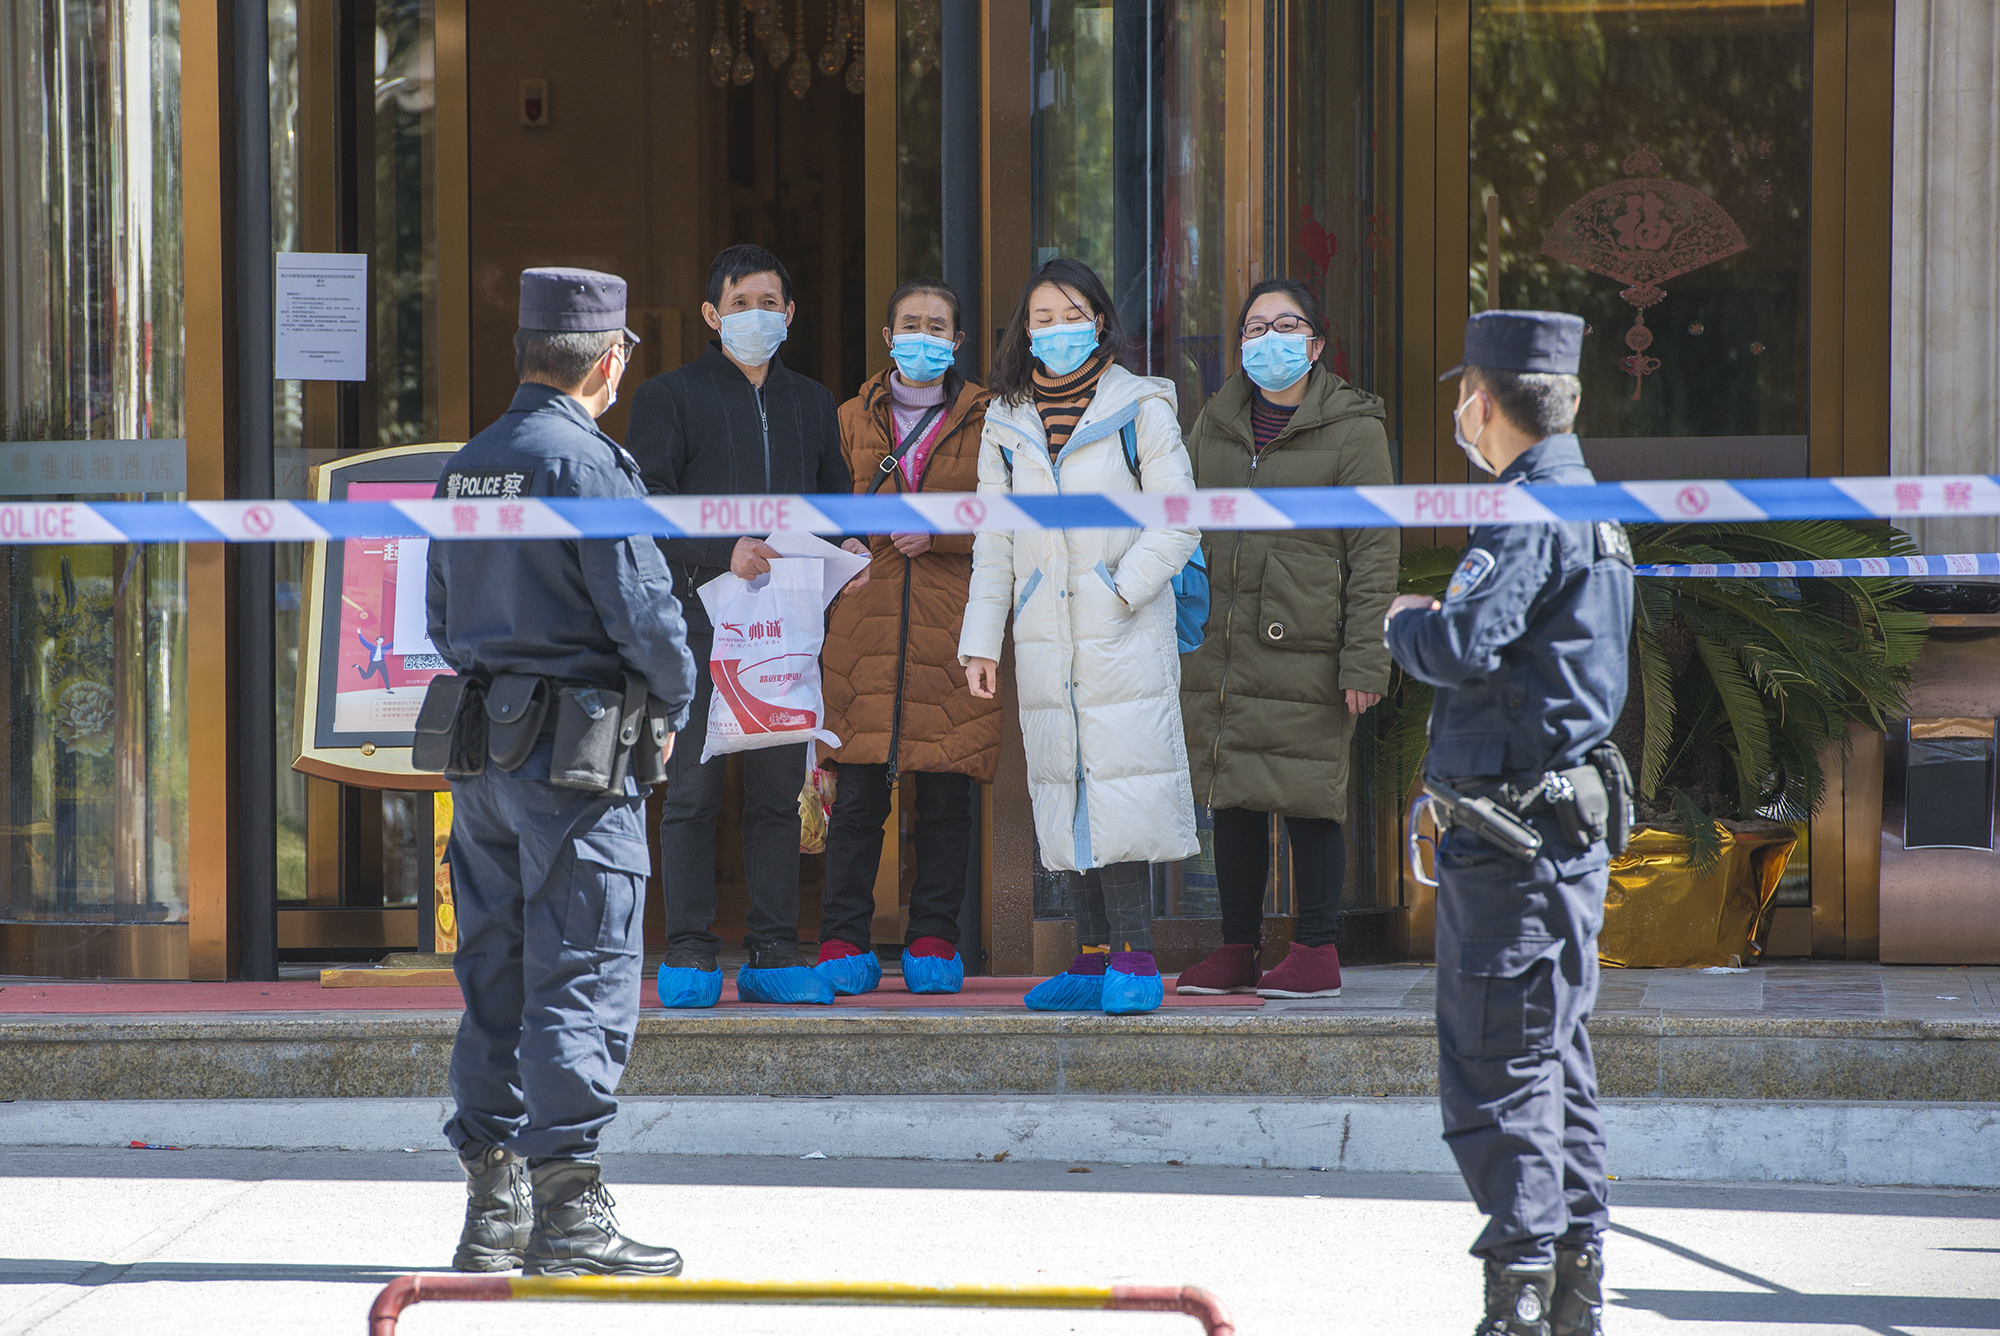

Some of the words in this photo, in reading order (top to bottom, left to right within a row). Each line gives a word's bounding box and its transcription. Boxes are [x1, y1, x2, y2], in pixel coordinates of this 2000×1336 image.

[461, 476, 502, 496] POLICE
[502, 472, 525, 499] 察
[1894, 481, 1972, 511] 警察
[452, 504, 525, 533] 警察
[700, 499, 790, 531] POLICE
[1163, 495, 1237, 524] 警察
[1415, 488, 1507, 520] POLICE
[0, 507, 76, 538] OLICE
